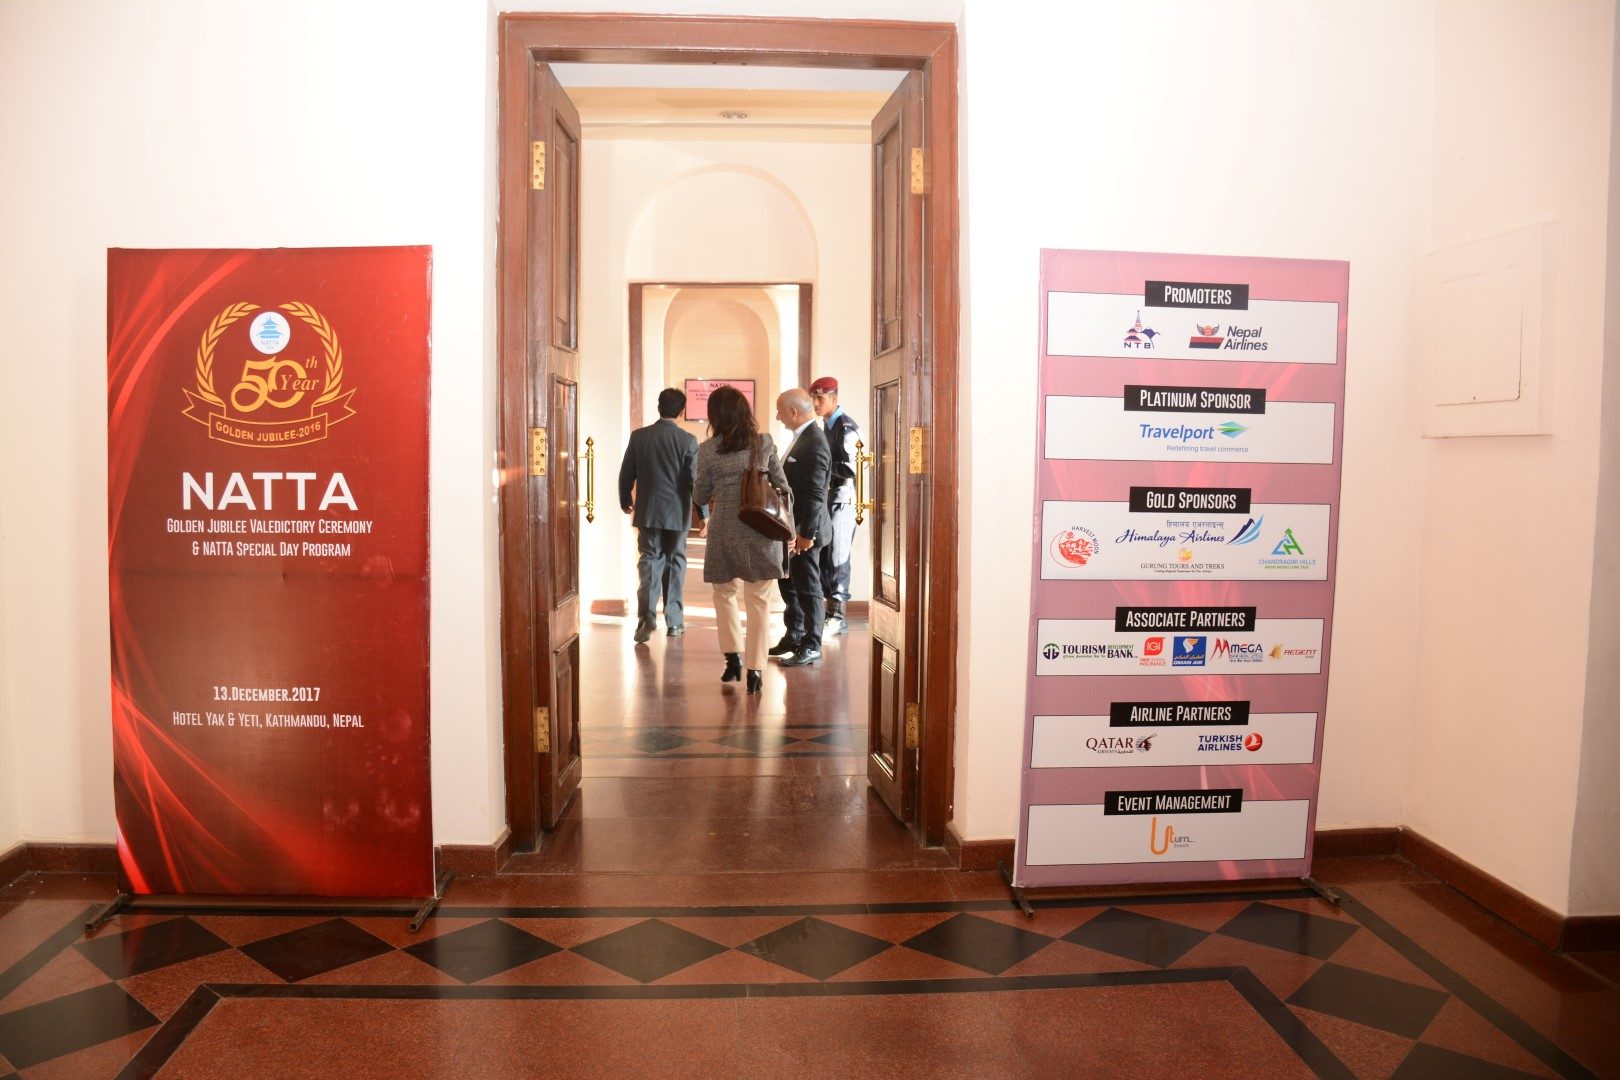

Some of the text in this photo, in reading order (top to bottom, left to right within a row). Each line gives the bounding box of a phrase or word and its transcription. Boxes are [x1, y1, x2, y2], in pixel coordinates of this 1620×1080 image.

[1164, 286, 1232, 305] PROMOTERS
[1226, 326, 1262, 341] Nepal
[1224, 338, 1268, 351] Airlines
[281, 374, 320, 391] Year
[1140, 389, 1251, 409] PLATINUM SPONSOR
[216, 421, 321, 442] GOLDEN JUBILEE-2016
[1139, 424, 1214, 442] Travelport
[1166, 445, 1198, 453] Redefining
[182, 472, 358, 510] NATTA
[1146, 492, 1236, 509] GOLD SPONSORS
[167, 518, 373, 534] GOLDEN JUBILEE VALEDICTORY CEREMONY
[1072, 526, 1095, 537] HARVEST
[1116, 529, 1224, 547] Himalaya Airlines
[192, 541, 351, 557] & NATTA SPECIAL DAY PROGRAM
[1126, 611, 1246, 627] ASSOCIATE PARTNERS
[1062, 645, 1106, 654] TOURISM
[1108, 650, 1133, 658] BANK
[213, 686, 321, 702] 13.DECEMBER.2017
[173, 712, 364, 730] HOTEL YAK & YETI, KATHMANDU, NEPAL
[1130, 706, 1232, 721] AIRLINE PARTNERS
[1086, 737, 1134, 751] QATAR
[1197, 743, 1242, 751] AIRLINES
[1199, 735, 1243, 743] TURKISH
[1118, 795, 1231, 811] EVENT MANAGEMENT
